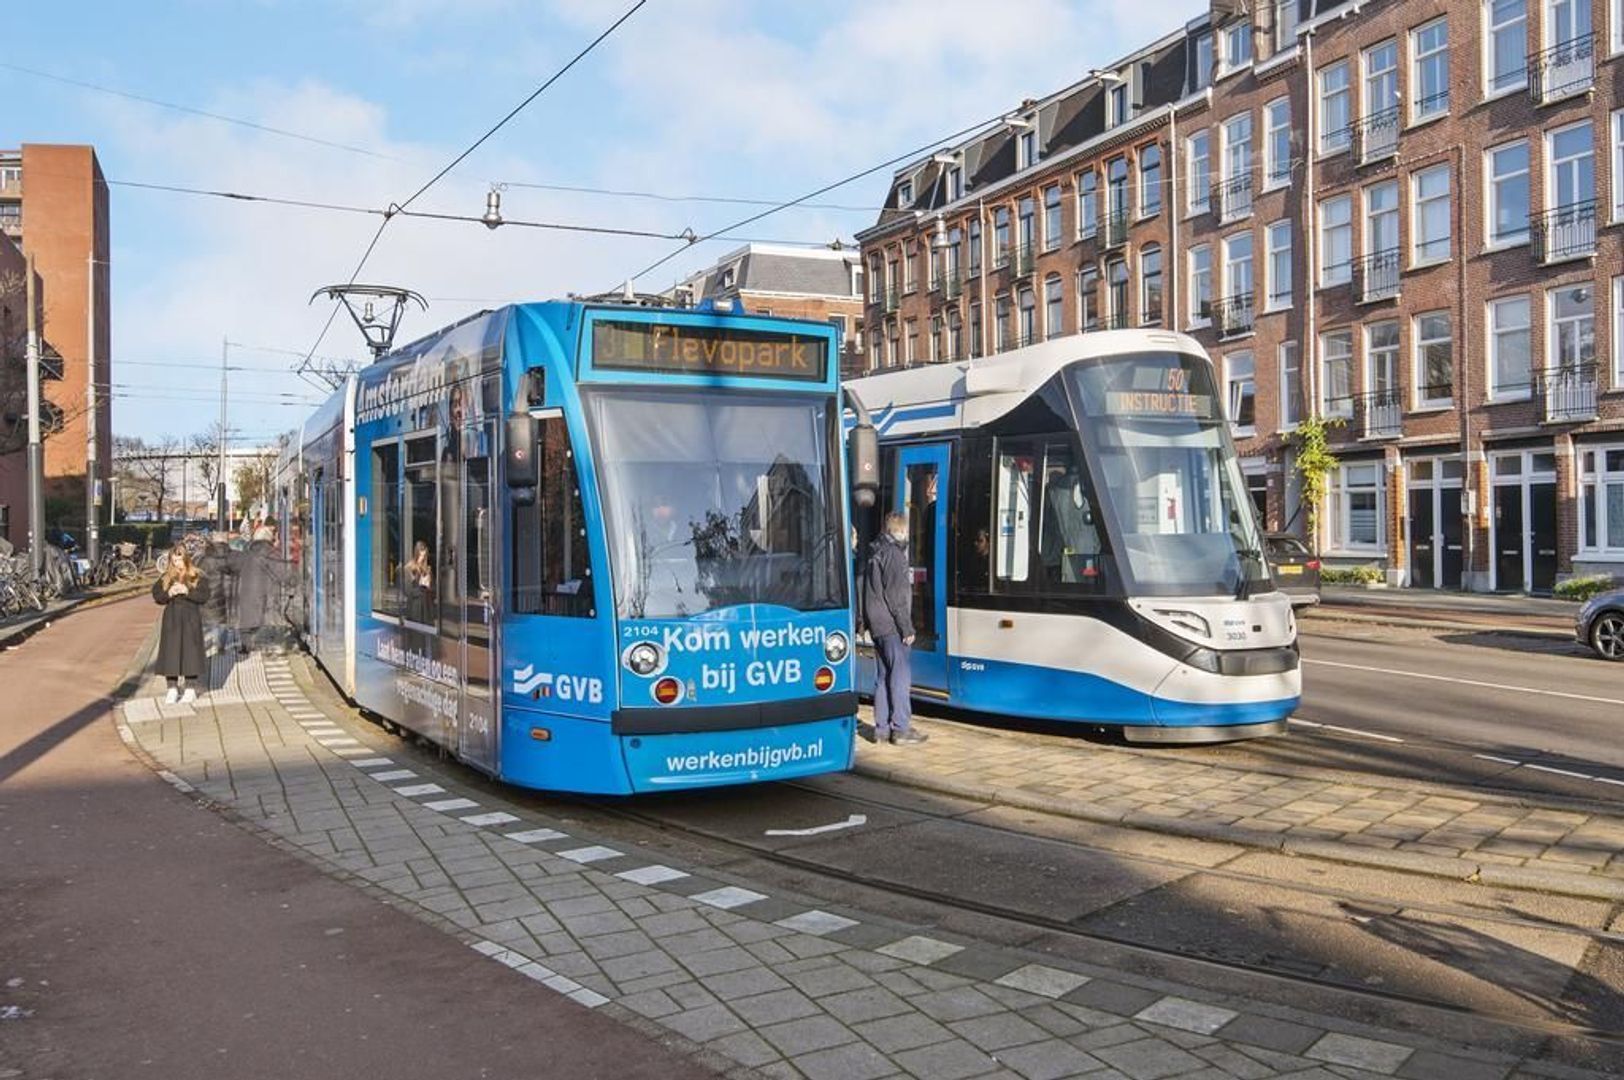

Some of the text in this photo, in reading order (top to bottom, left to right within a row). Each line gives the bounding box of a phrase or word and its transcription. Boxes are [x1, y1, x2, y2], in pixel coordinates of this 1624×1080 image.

[652, 326, 808, 370] Flevopark
[1167, 368, 1185, 390] 50
[623, 626, 658, 637] 2104
[662, 622, 826, 652] Kom werken
[556, 674, 603, 704] GVB
[701, 659, 801, 693] bij GVB
[666, 738, 823, 772] werkenbijgvb.nl
